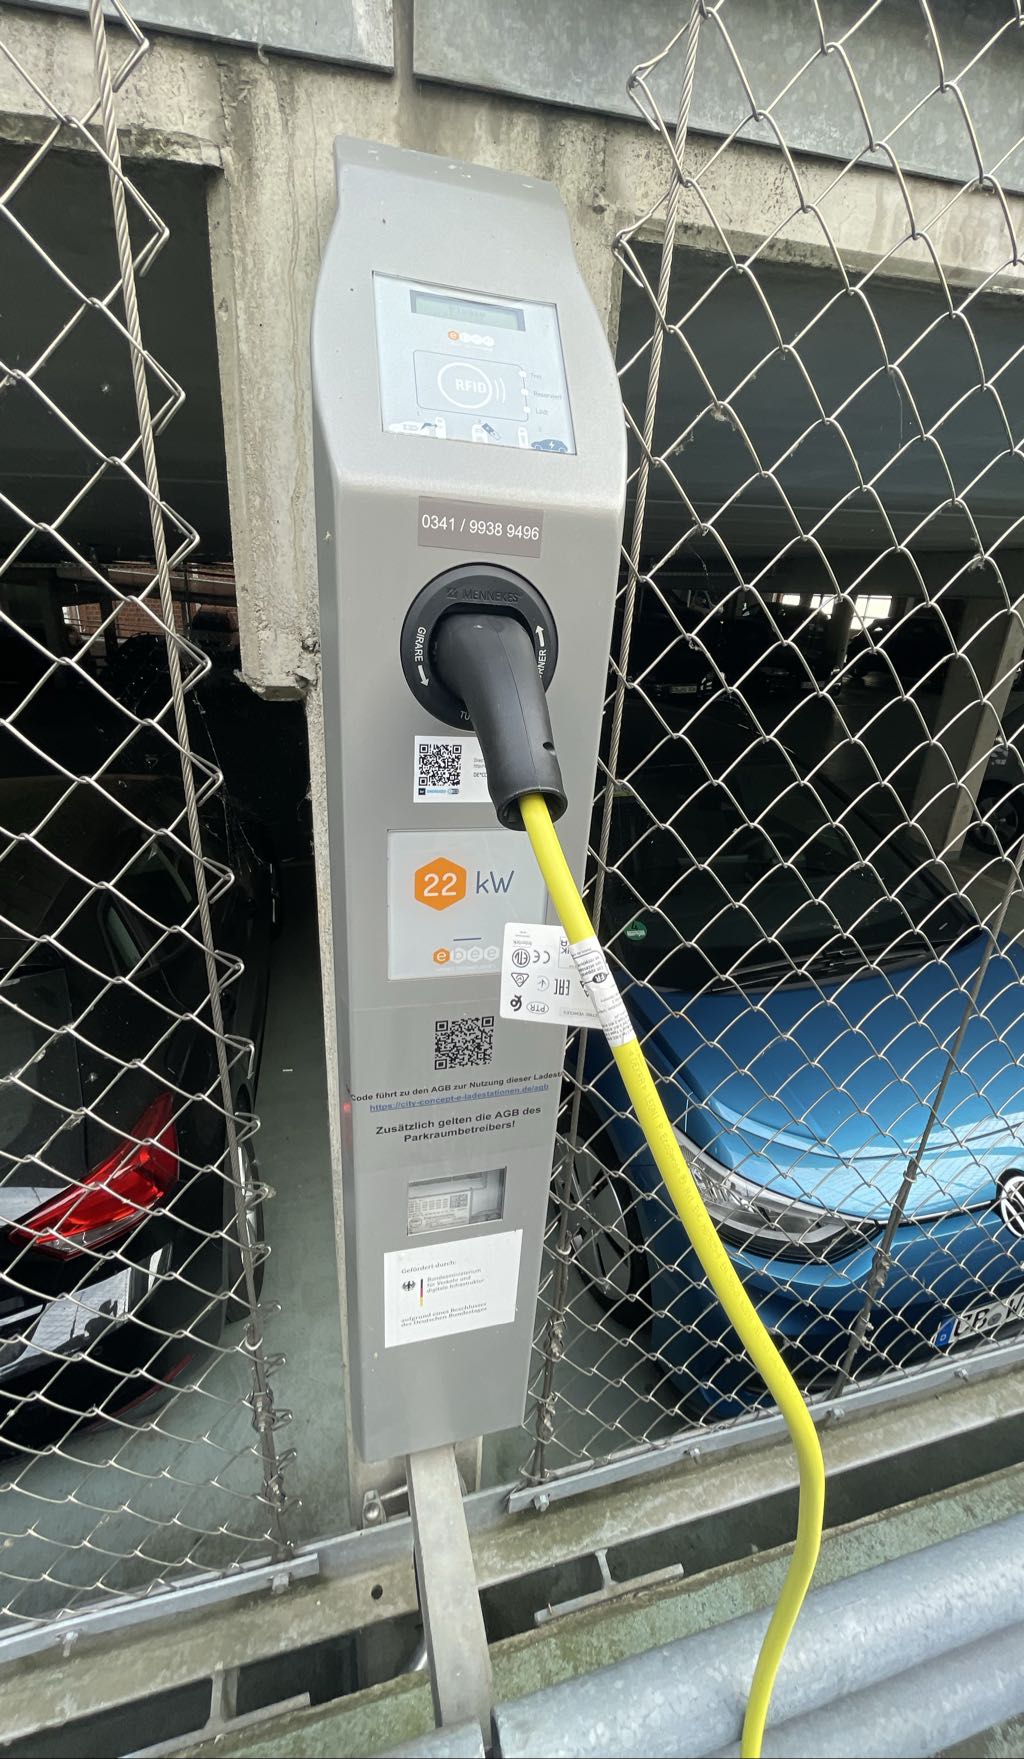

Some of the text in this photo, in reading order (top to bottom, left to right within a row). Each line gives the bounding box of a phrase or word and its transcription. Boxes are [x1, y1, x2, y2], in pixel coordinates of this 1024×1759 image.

[455, 378, 487, 395] RFID
[421, 514, 540, 541] 0341 / 9938 9496
[463, 588, 519, 602] MENNEKES
[414, 626, 427, 662] GIRARE
[423, 870, 515, 897] 22 kW
[532, 950, 550, 964] CE
[530, 1004, 546, 1012] PTR
[375, 1091, 398, 1099] führt
[430, 1084, 451, 1093] AGB
[469, 1079, 504, 1089] Nutzung
[506, 1075, 531, 1084] dieser
[376, 1106, 541, 1135] Zusätzlich gelten die AGB des
[404, 1120, 516, 1143] Parkraumbetreibers!
